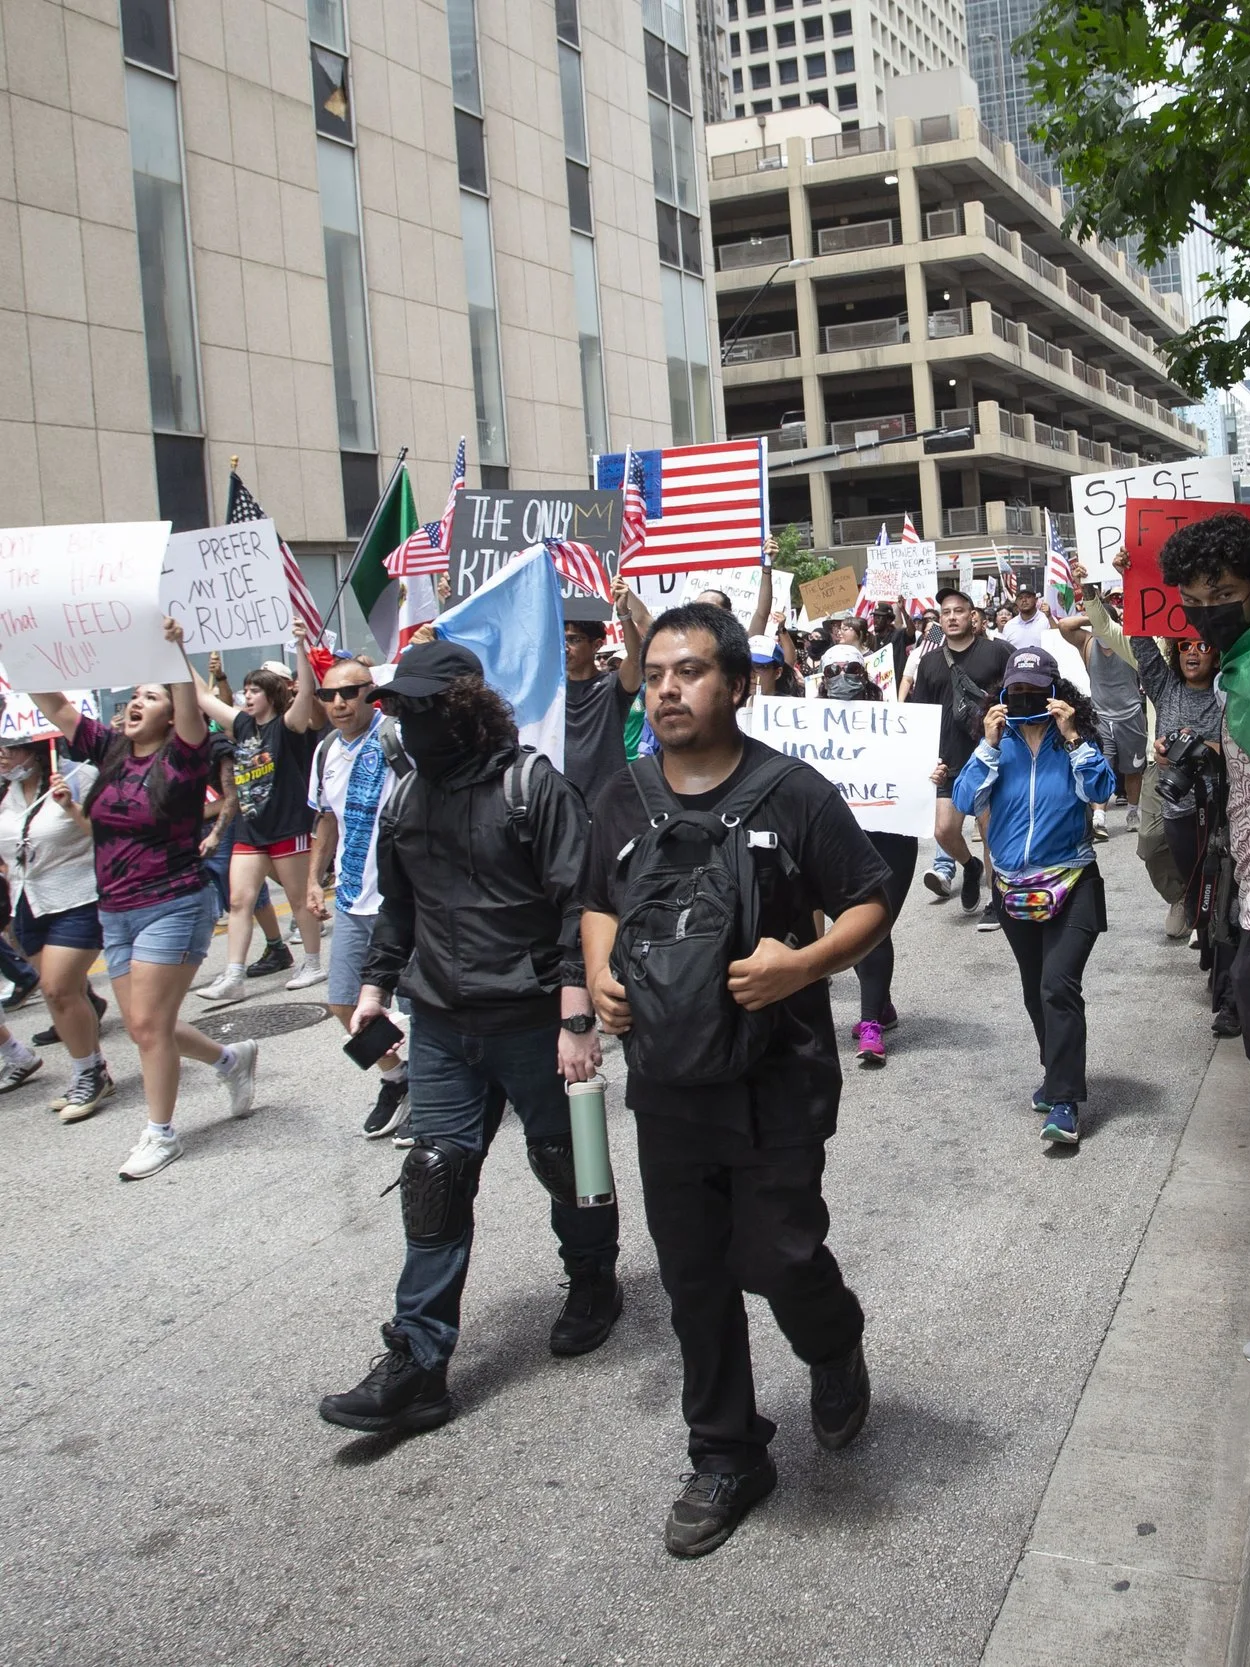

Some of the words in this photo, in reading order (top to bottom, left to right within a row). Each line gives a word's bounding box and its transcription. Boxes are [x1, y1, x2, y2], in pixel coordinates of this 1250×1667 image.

[465, 495, 514, 541] THE
[522, 498, 573, 544] ONLY
[198, 530, 270, 571] PREFER
[868, 548, 887, 560] THE
[891, 546, 917, 558] POWER
[922, 546, 933, 557] OF
[880, 560, 901, 570] THE
[903, 557, 932, 569] PEOPLE
[188, 578, 216, 604] MY
[219, 563, 257, 602] ICE
[62, 600, 132, 638] FEED
[168, 596, 290, 645] CRUSHED
[3, 698, 94, 735] AMEA
[763, 703, 808, 731] ICE
[251, 762, 275, 780] TOUR
[1201, 884, 1212, 912] Canon
